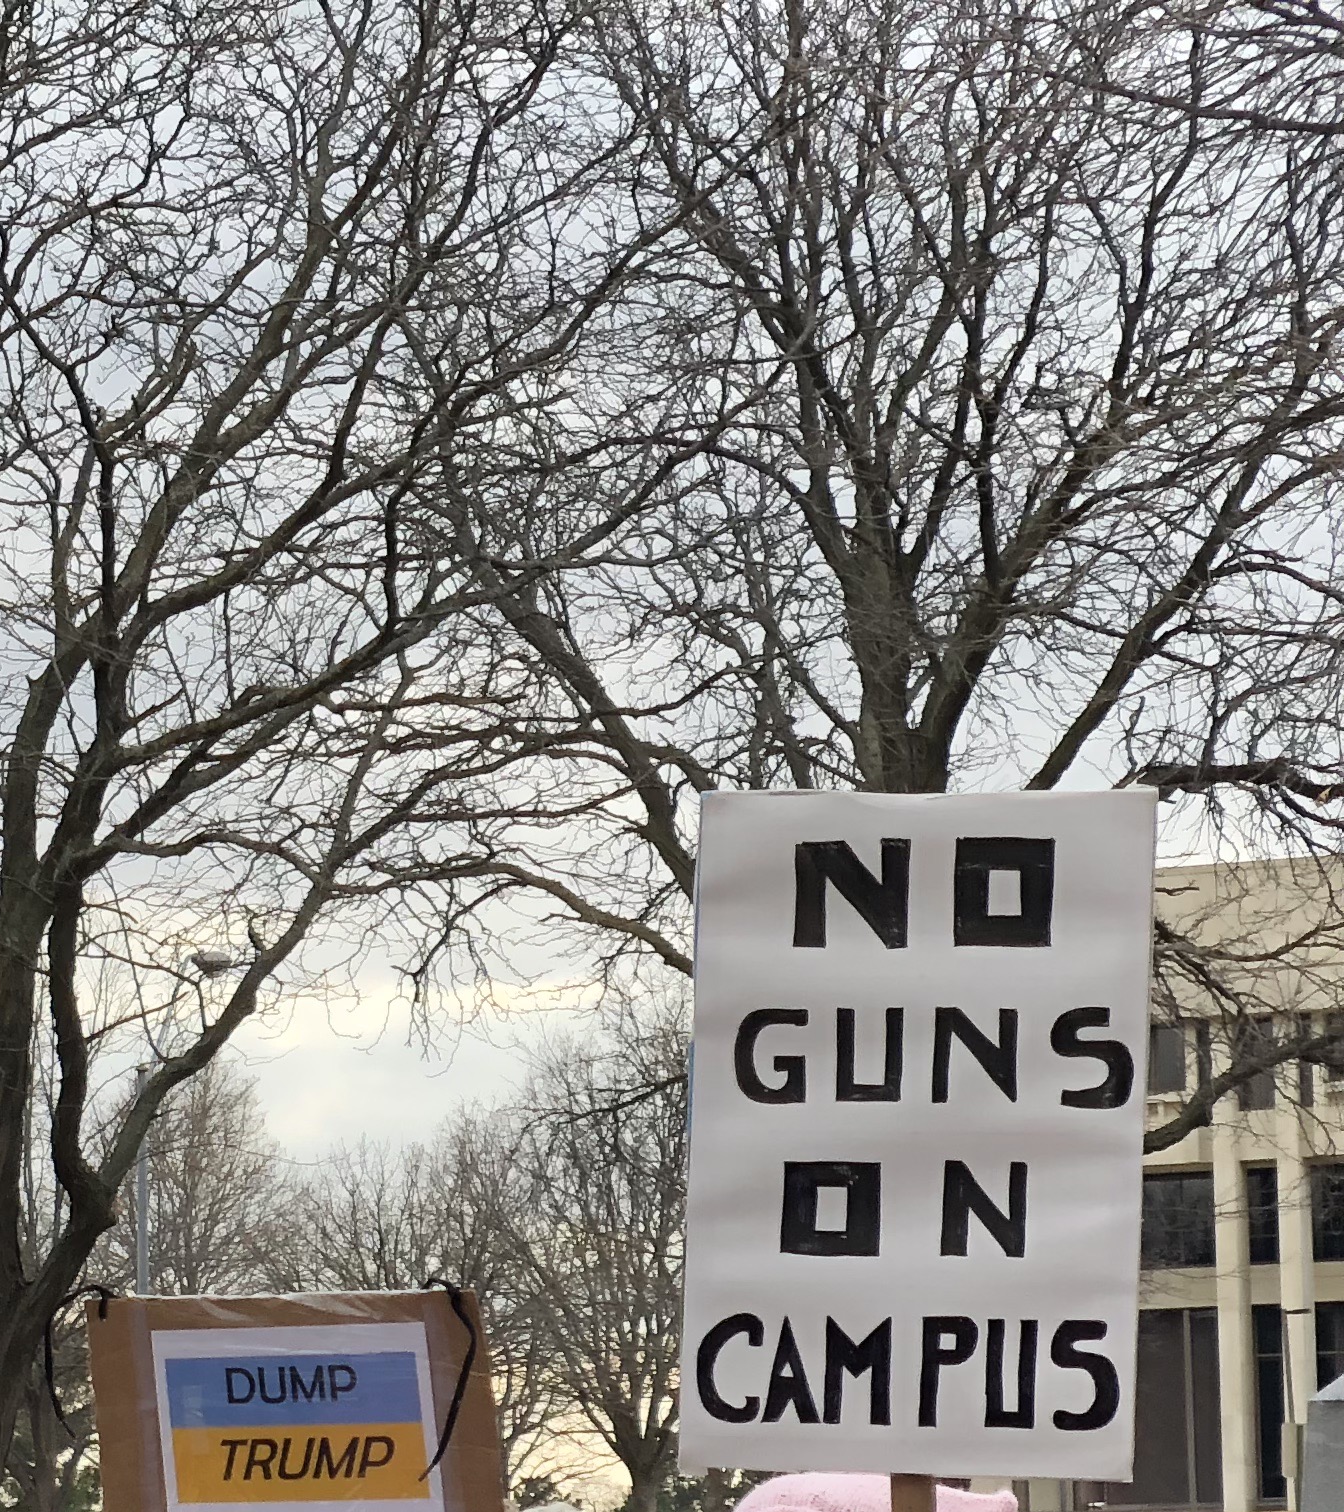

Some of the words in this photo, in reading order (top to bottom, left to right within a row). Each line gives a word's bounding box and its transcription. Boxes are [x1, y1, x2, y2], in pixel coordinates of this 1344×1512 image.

[792, 836, 1056, 949] NO
[733, 1007, 1135, 1110] GUNS
[779, 1159, 1028, 1258] ON
[224, 1364, 358, 1404] DUMP
[696, 1312, 1121, 1431] CAMPUS
[219, 1435, 395, 1481] TRUMP
